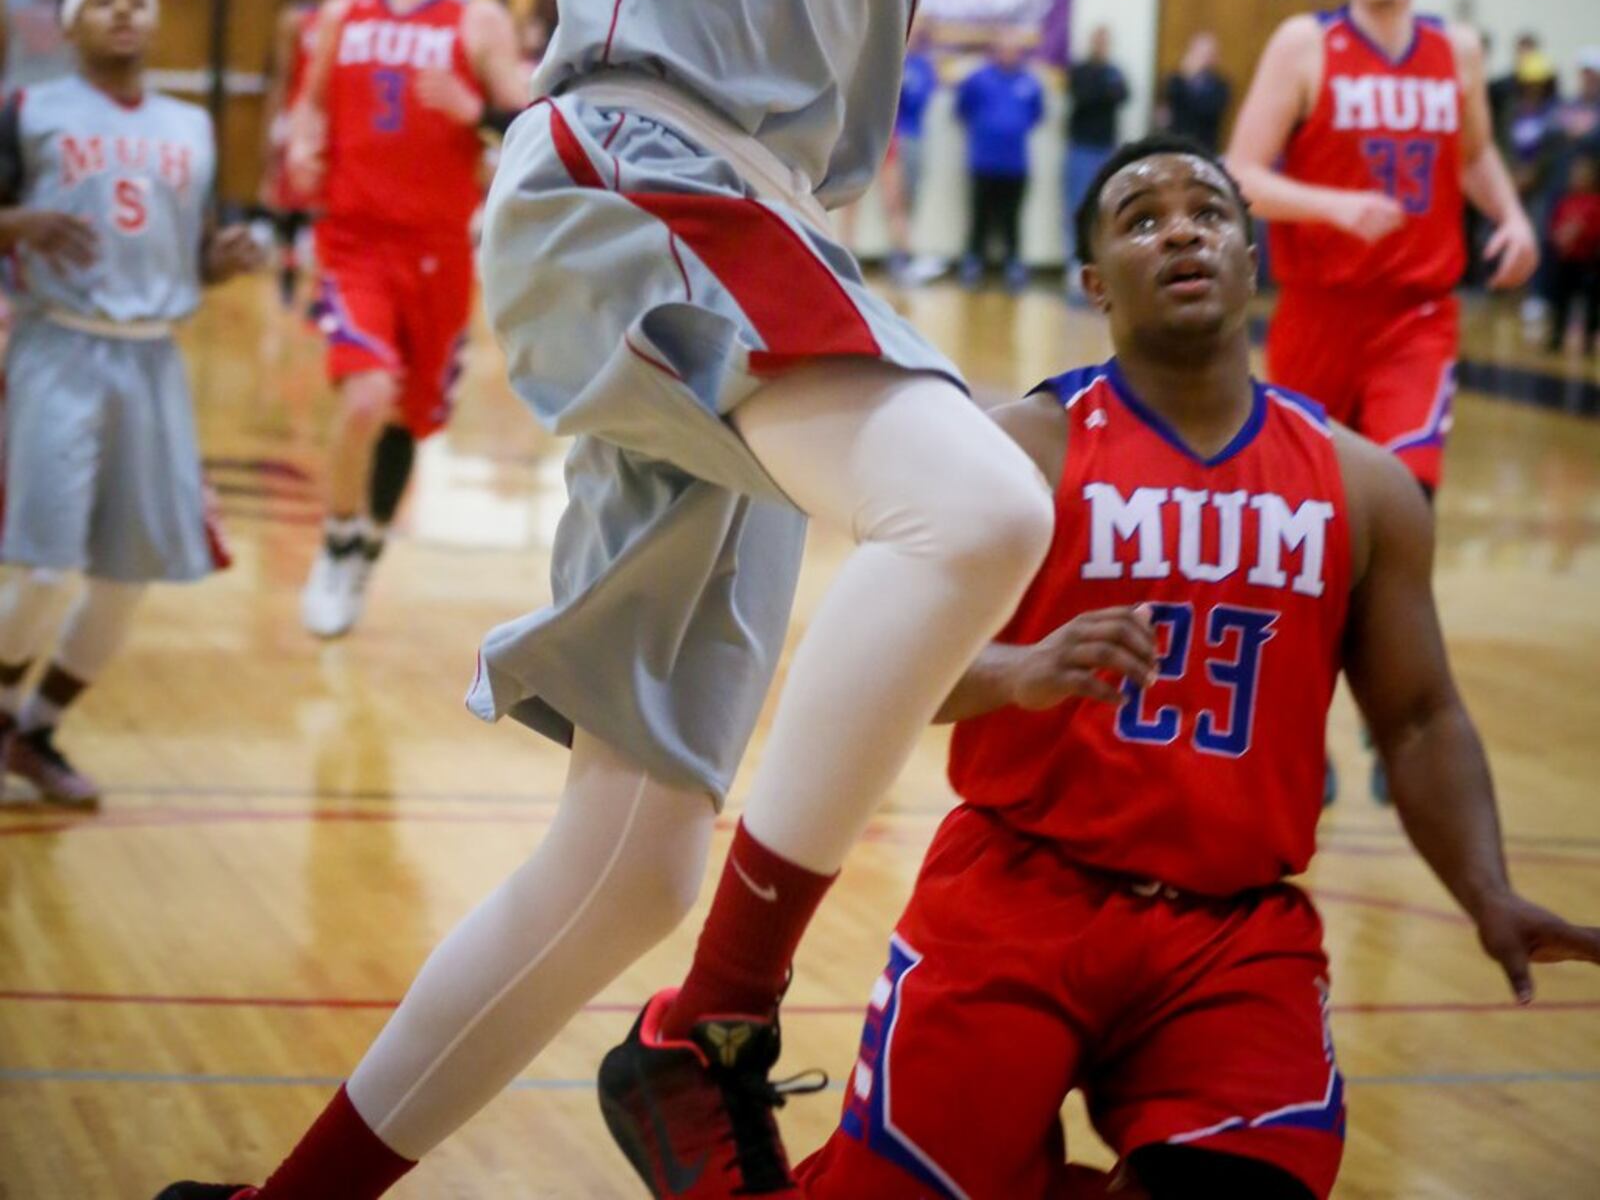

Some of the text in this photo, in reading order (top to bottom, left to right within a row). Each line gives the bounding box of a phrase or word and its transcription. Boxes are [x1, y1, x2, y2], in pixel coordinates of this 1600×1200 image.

[339, 18, 456, 69] MUM
[370, 68, 404, 133] 3
[1330, 74, 1459, 133] MUM
[57, 133, 195, 204] MUH
[1362, 137, 1437, 216] 33
[1081, 481, 1334, 598] MUM
[1113, 600, 1281, 759] 23
